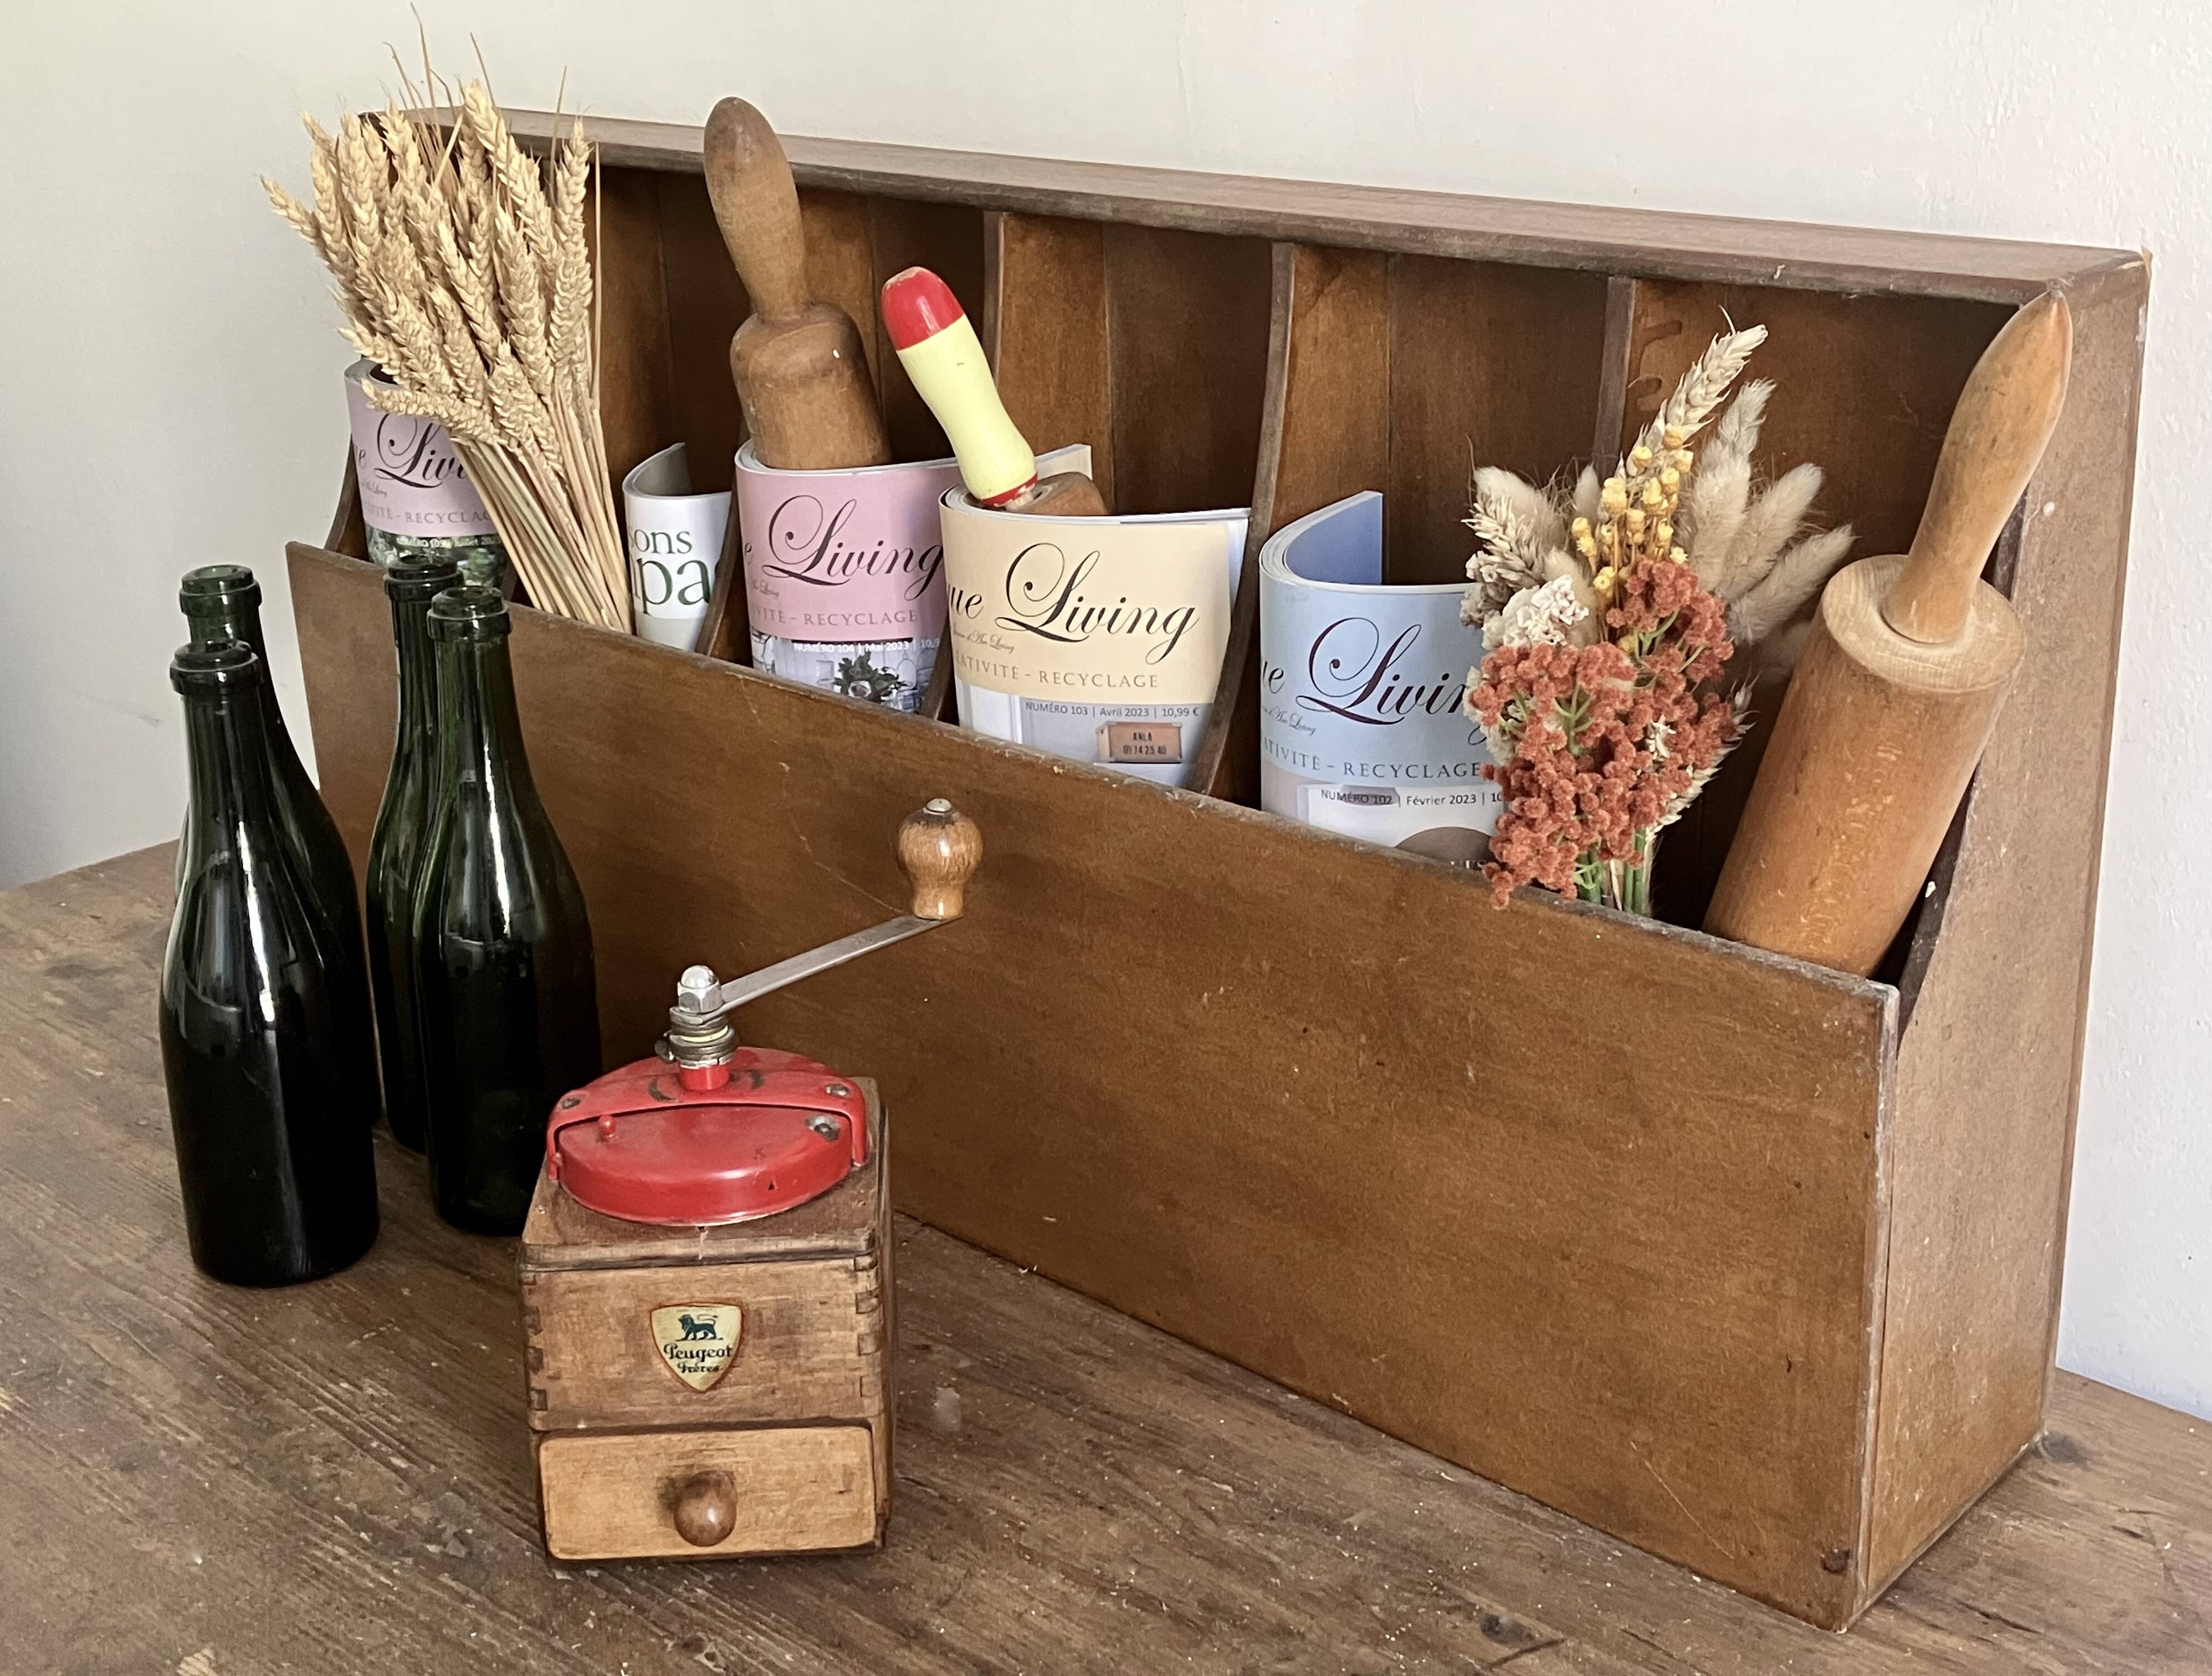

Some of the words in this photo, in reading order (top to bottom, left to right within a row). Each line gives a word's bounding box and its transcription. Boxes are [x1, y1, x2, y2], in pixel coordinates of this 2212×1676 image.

[761, 494, 944, 601] Living
[632, 557, 716, 616] pa
[995, 542, 1201, 665] Living
[804, 610, 919, 626] RECYCLAGE
[887, 641, 909, 652] 2023
[1038, 670, 1159, 688] RECYCLAGE
[1296, 617, 1487, 745] Livi
[1025, 702, 1068, 714] NUMÉRO
[1071, 706, 1088, 716] 103
[1099, 707, 1122, 717] Avril
[1125, 707, 1150, 717] 2023
[1162, 707, 1190, 718] 10,99
[1343, 762, 1481, 779] RECYCLAGE
[1320, 789, 1369, 804] NUMÉRO
[1374, 795, 1392, 805] 102
[1406, 795, 1445, 805] Février
[1449, 794, 1477, 804] 2023
[663, 1343, 733, 1363] Peugeot
